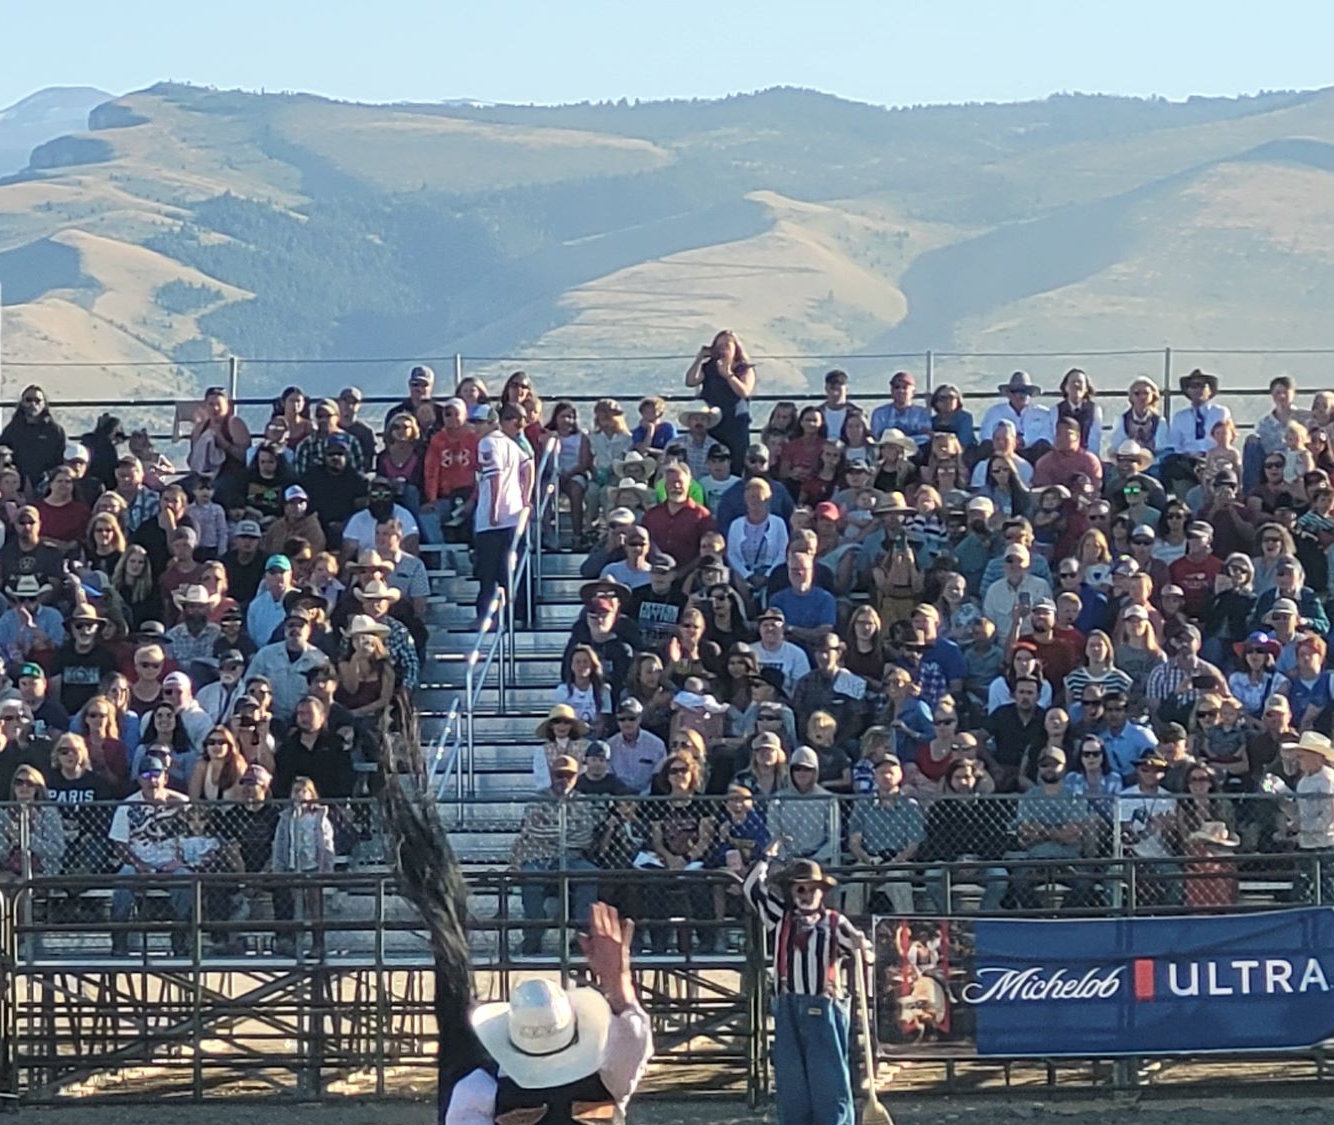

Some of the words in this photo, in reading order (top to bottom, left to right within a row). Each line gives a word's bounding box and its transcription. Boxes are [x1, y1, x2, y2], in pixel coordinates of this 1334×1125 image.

[48, 788, 95, 803] PARIS
[961, 965, 1128, 1005] Michelob
[1168, 957, 1329, 997] ULTRA
